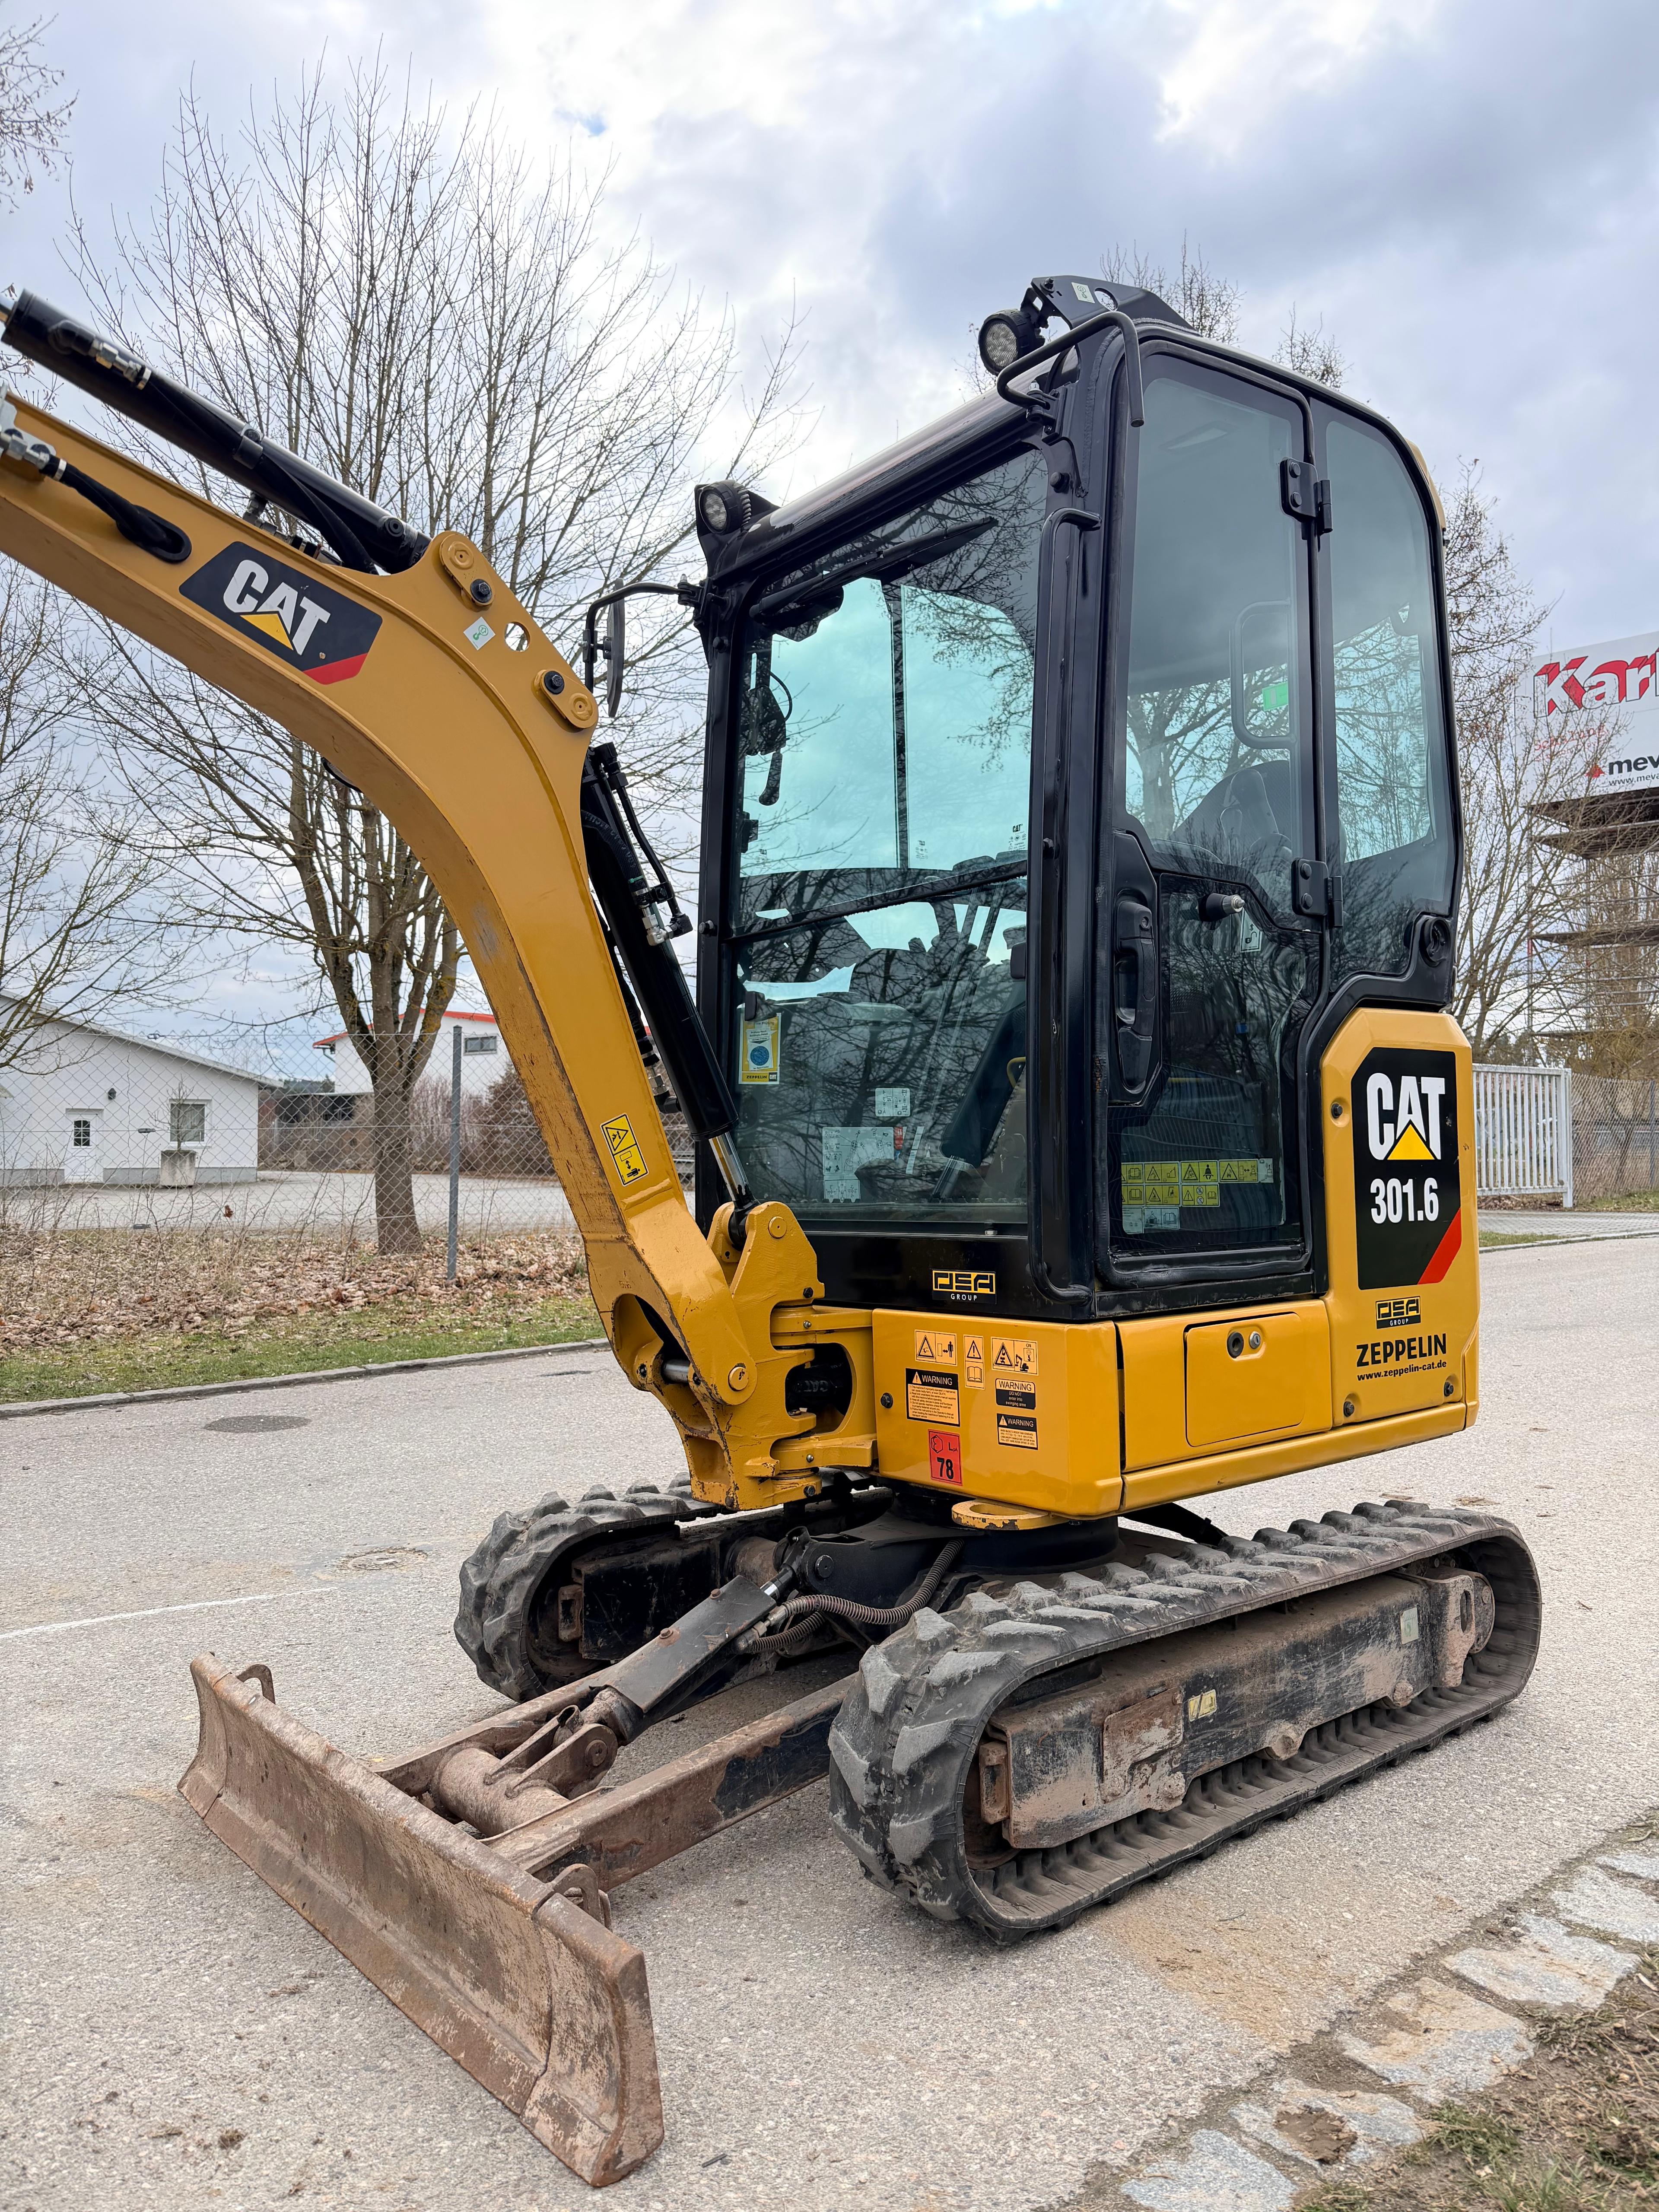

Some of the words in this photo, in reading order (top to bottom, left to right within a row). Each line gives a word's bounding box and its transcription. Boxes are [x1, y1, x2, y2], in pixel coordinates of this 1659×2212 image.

[223, 560, 331, 655] CAT
[1534, 646, 1659, 718] Kar
[1013, 823, 1021, 833] CAT
[1367, 1073, 1445, 1160] CAT
[1370, 1177, 1439, 1224] 301.6
[1389, 1318, 1409, 1326] GROUP
[1356, 1333, 1446, 1367] ZEPPELIN
[922, 1374, 953, 1385] WARNING
[1357, 1360, 1447, 1381] www.zeppelin-cat.de
[999, 1380, 1032, 1391] WARNING
[1007, 1417, 1034, 1427] WARNING
[936, 1456, 954, 1480] 78
